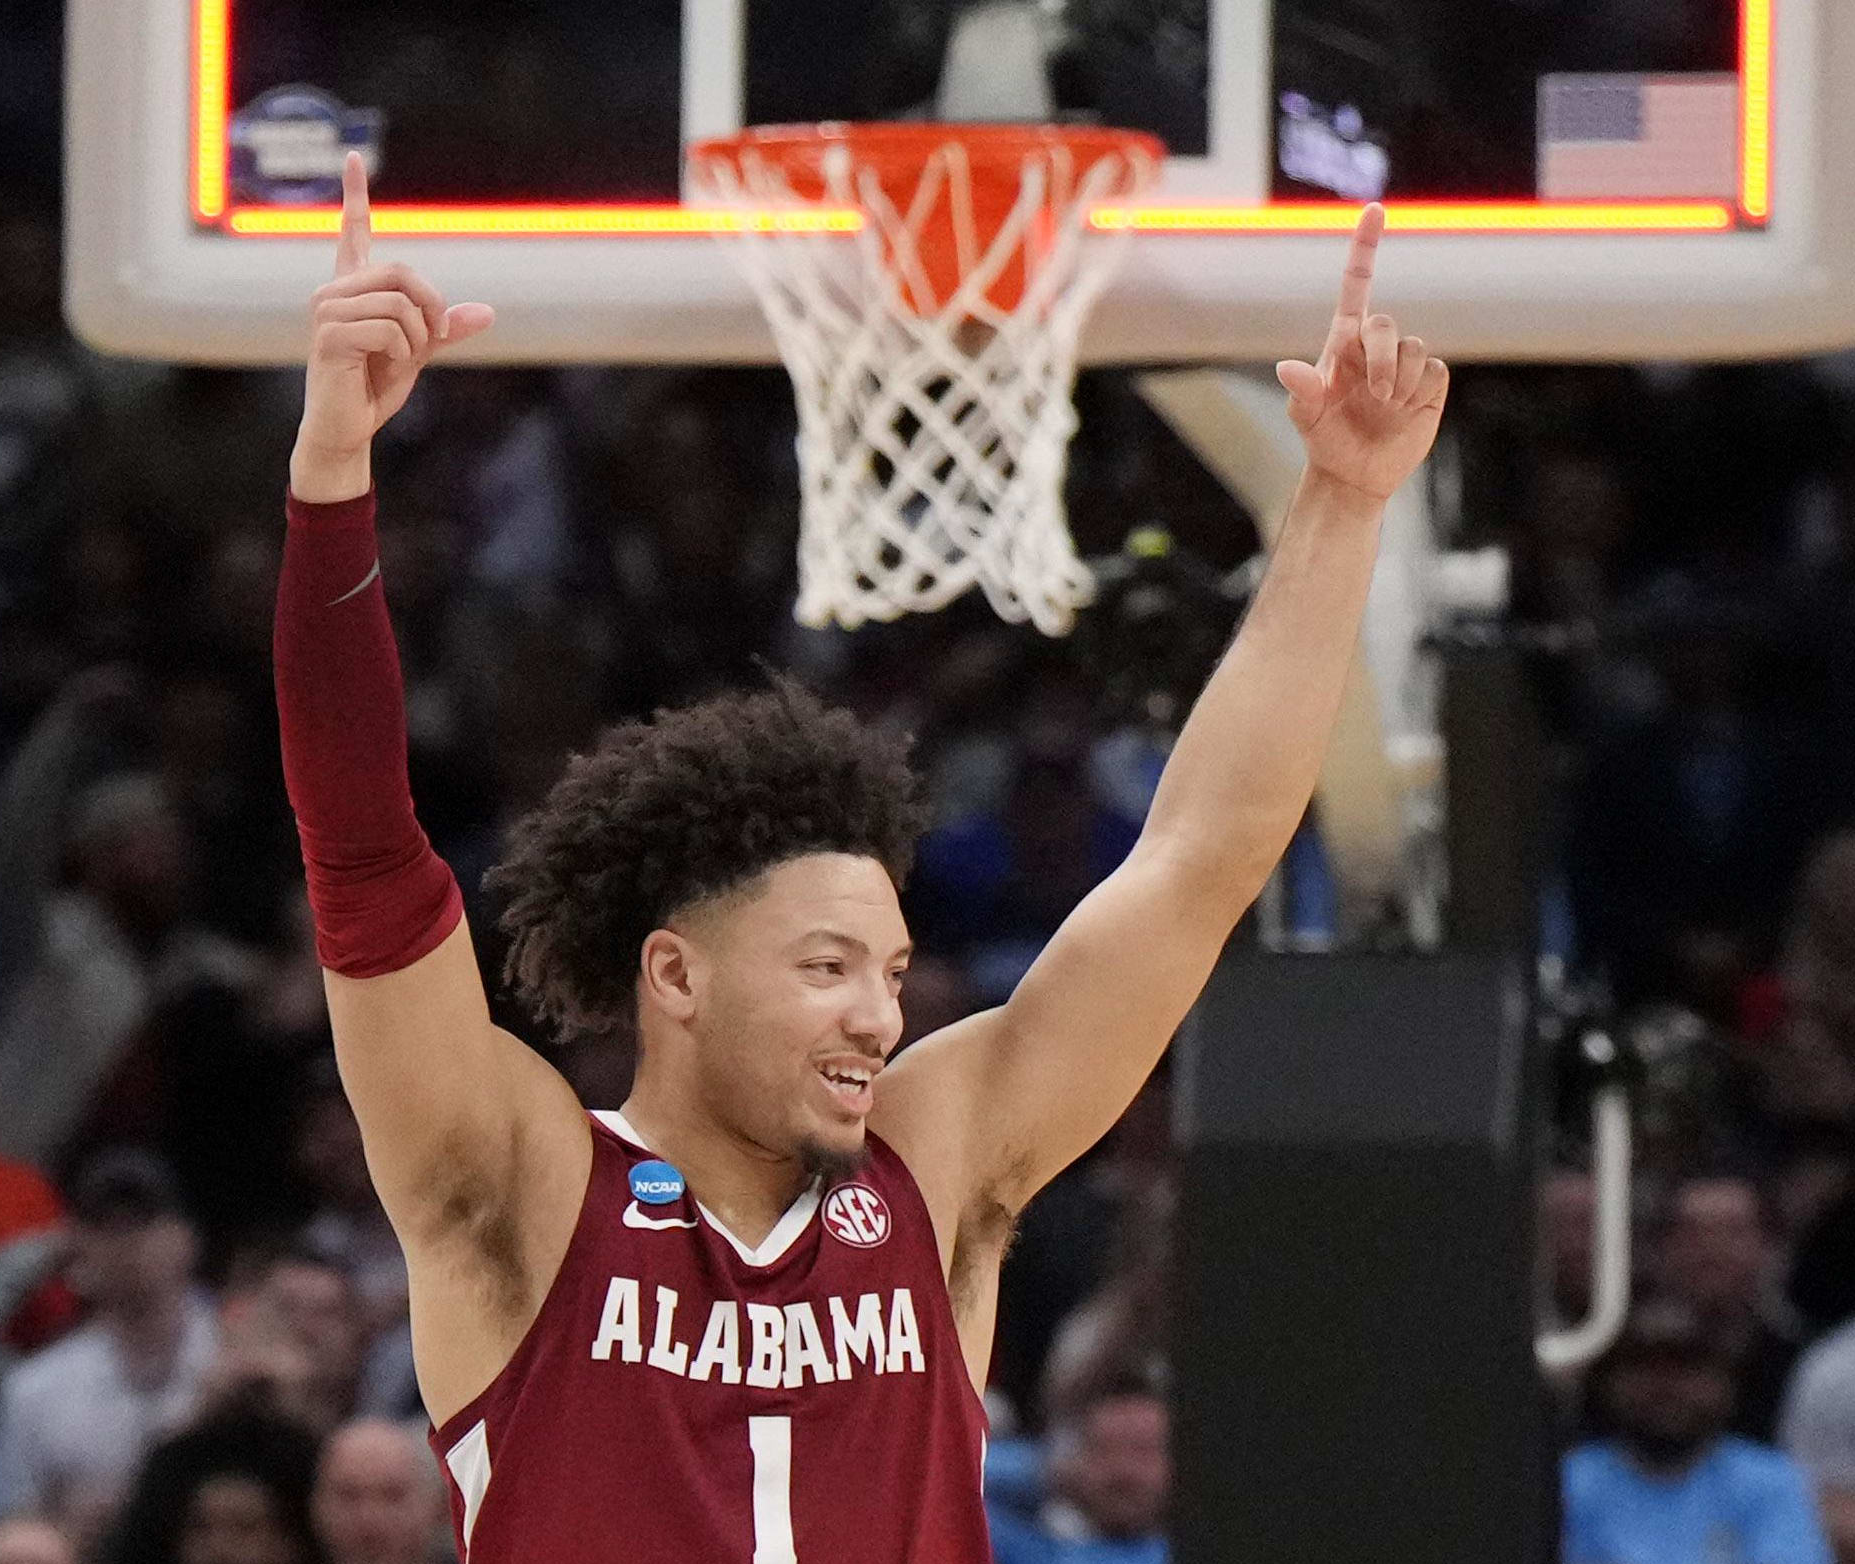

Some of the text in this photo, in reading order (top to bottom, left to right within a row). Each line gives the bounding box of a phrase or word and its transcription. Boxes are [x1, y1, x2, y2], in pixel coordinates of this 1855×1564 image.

[634, 1180, 682, 1194] NCAA
[826, 1187, 888, 1245] SEC
[590, 1276, 926, 1389] ALABAMA
